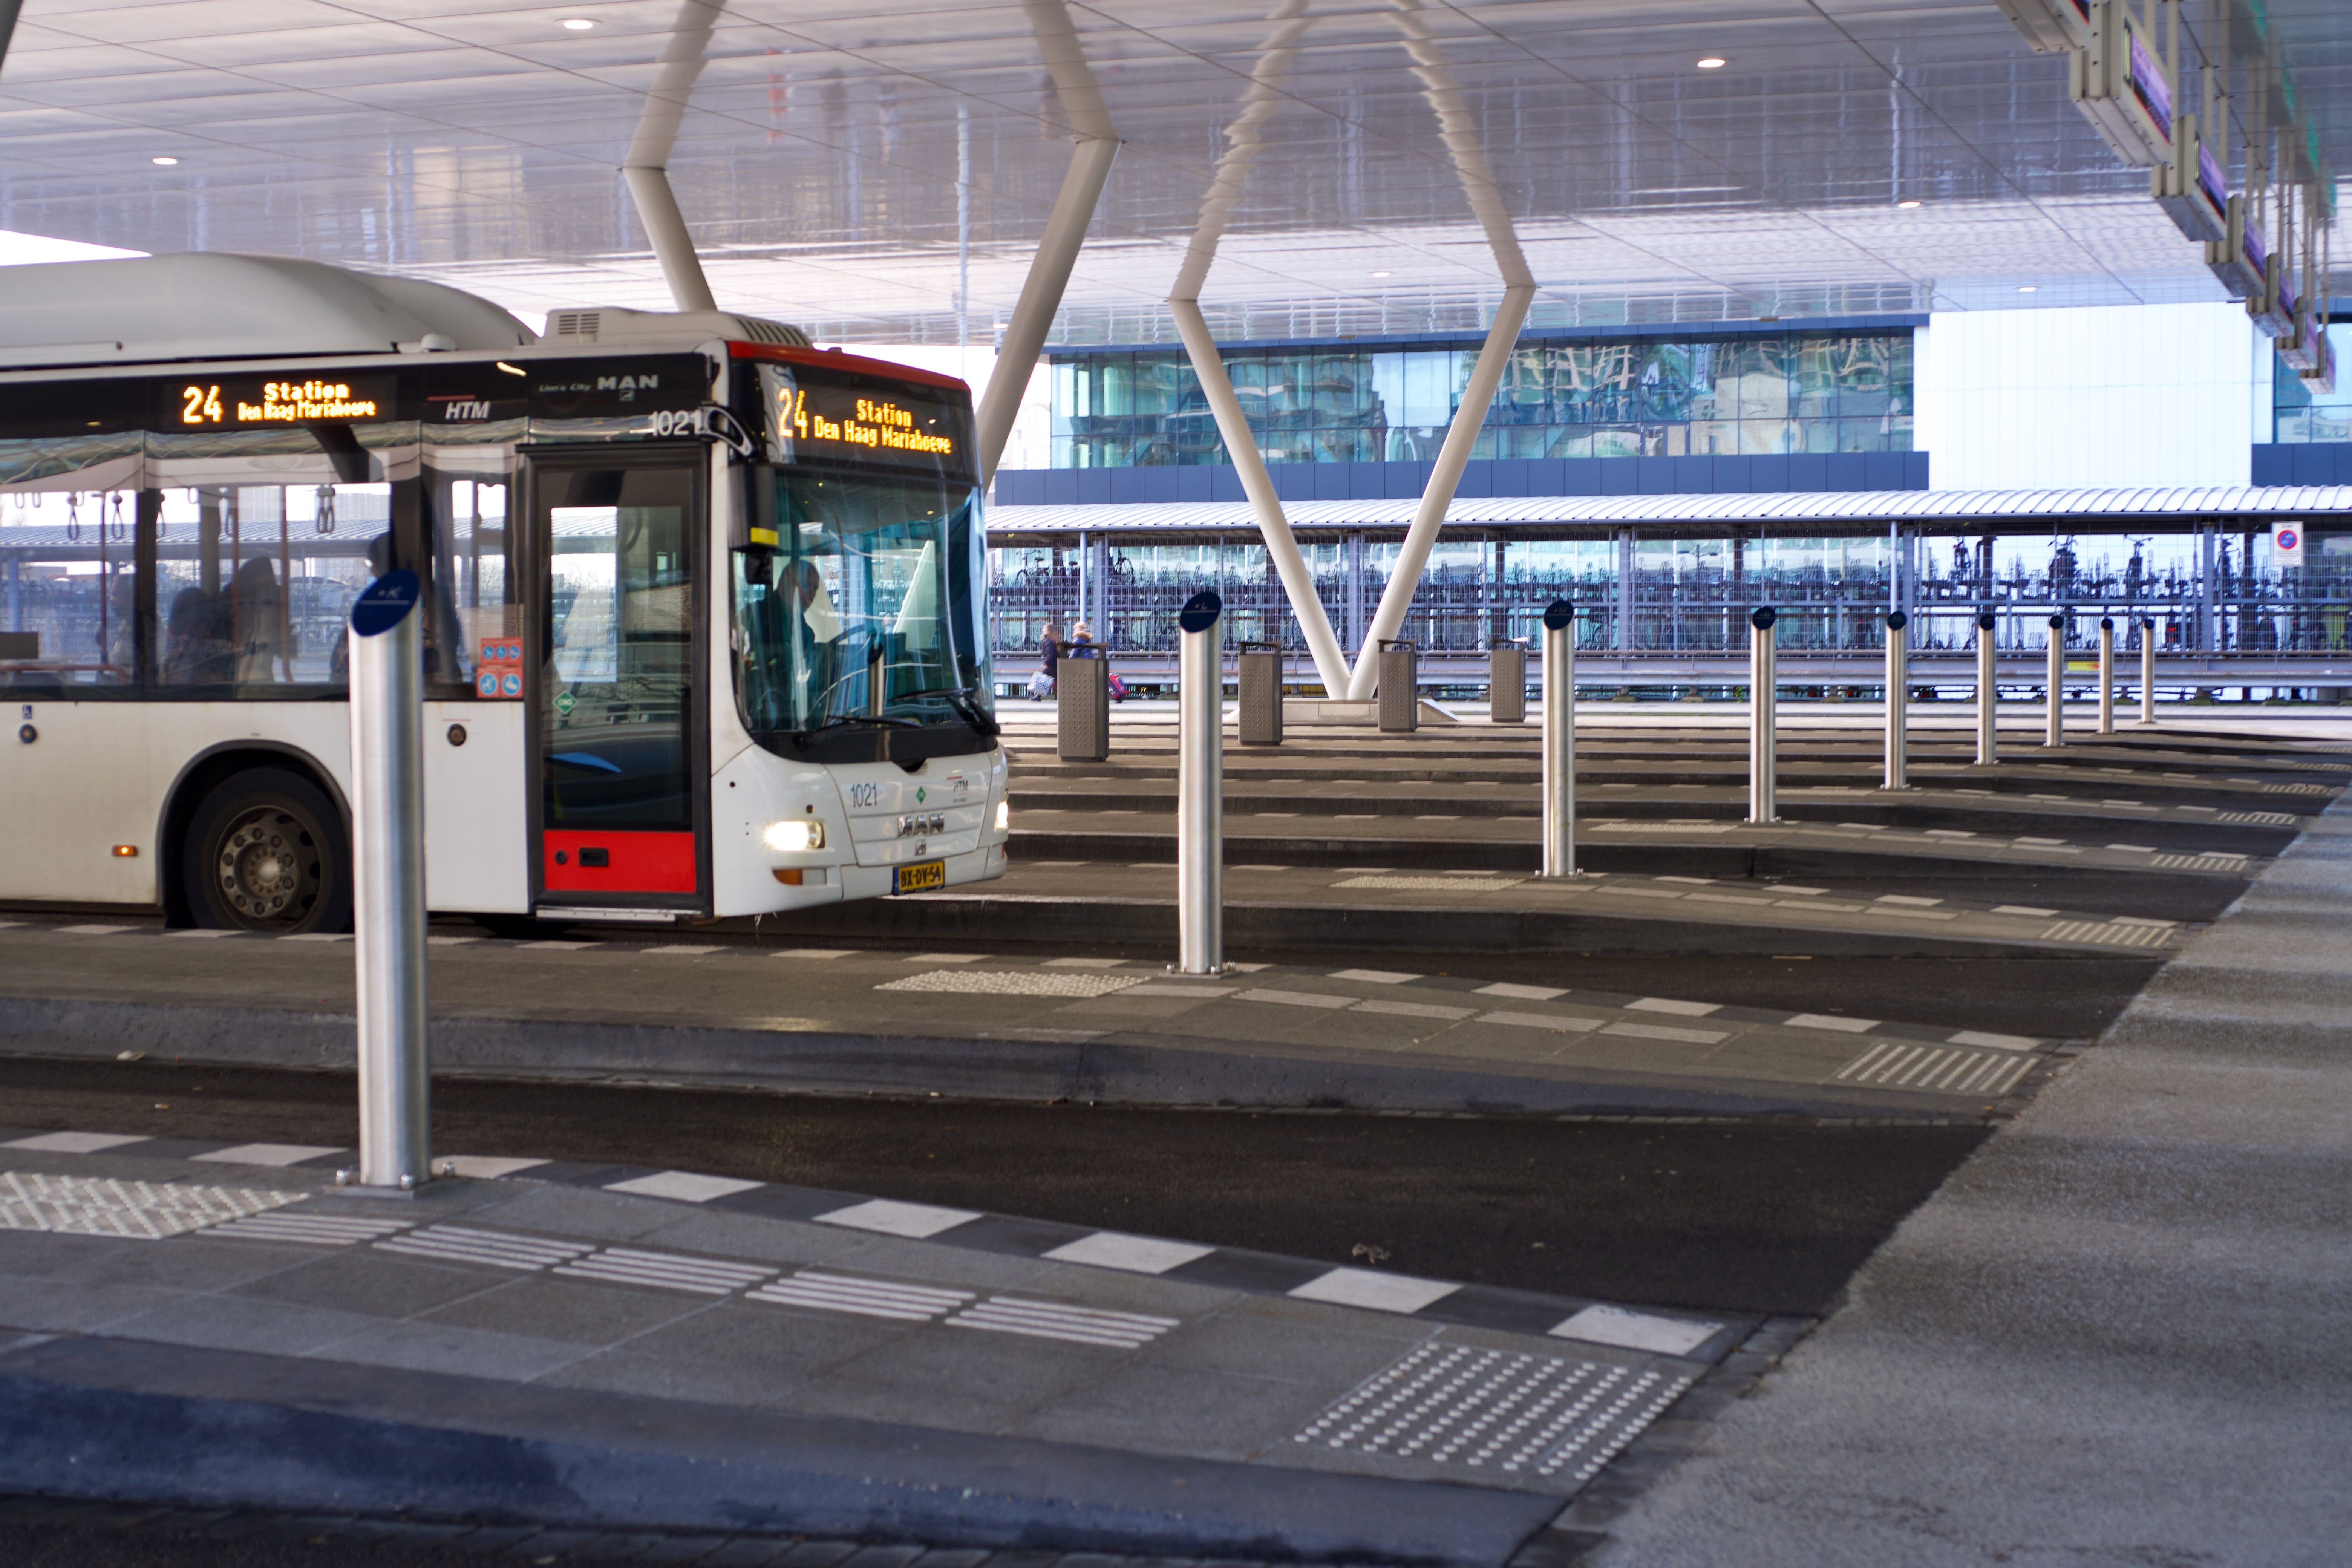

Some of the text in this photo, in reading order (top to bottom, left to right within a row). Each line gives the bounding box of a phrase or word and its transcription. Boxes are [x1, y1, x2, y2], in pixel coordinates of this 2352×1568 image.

[264, 381, 350, 401] Station
[569, 383, 592, 392] City
[597, 375, 658, 390] MAN
[183, 385, 224, 423] 24
[238, 398, 376, 421] Den Haag Mariahoeve
[445, 401, 491, 419] HTM
[778, 387, 808, 439] 24
[856, 399, 912, 427] Station
[648, 409, 702, 436] 1021
[814, 415, 952, 454] Den Haag Mariahoeve
[851, 783, 877, 808] 1021
[953, 779, 968, 792] HTM
[897, 812, 945, 837] MAN
[901, 865, 941, 887] BX-DV-54
